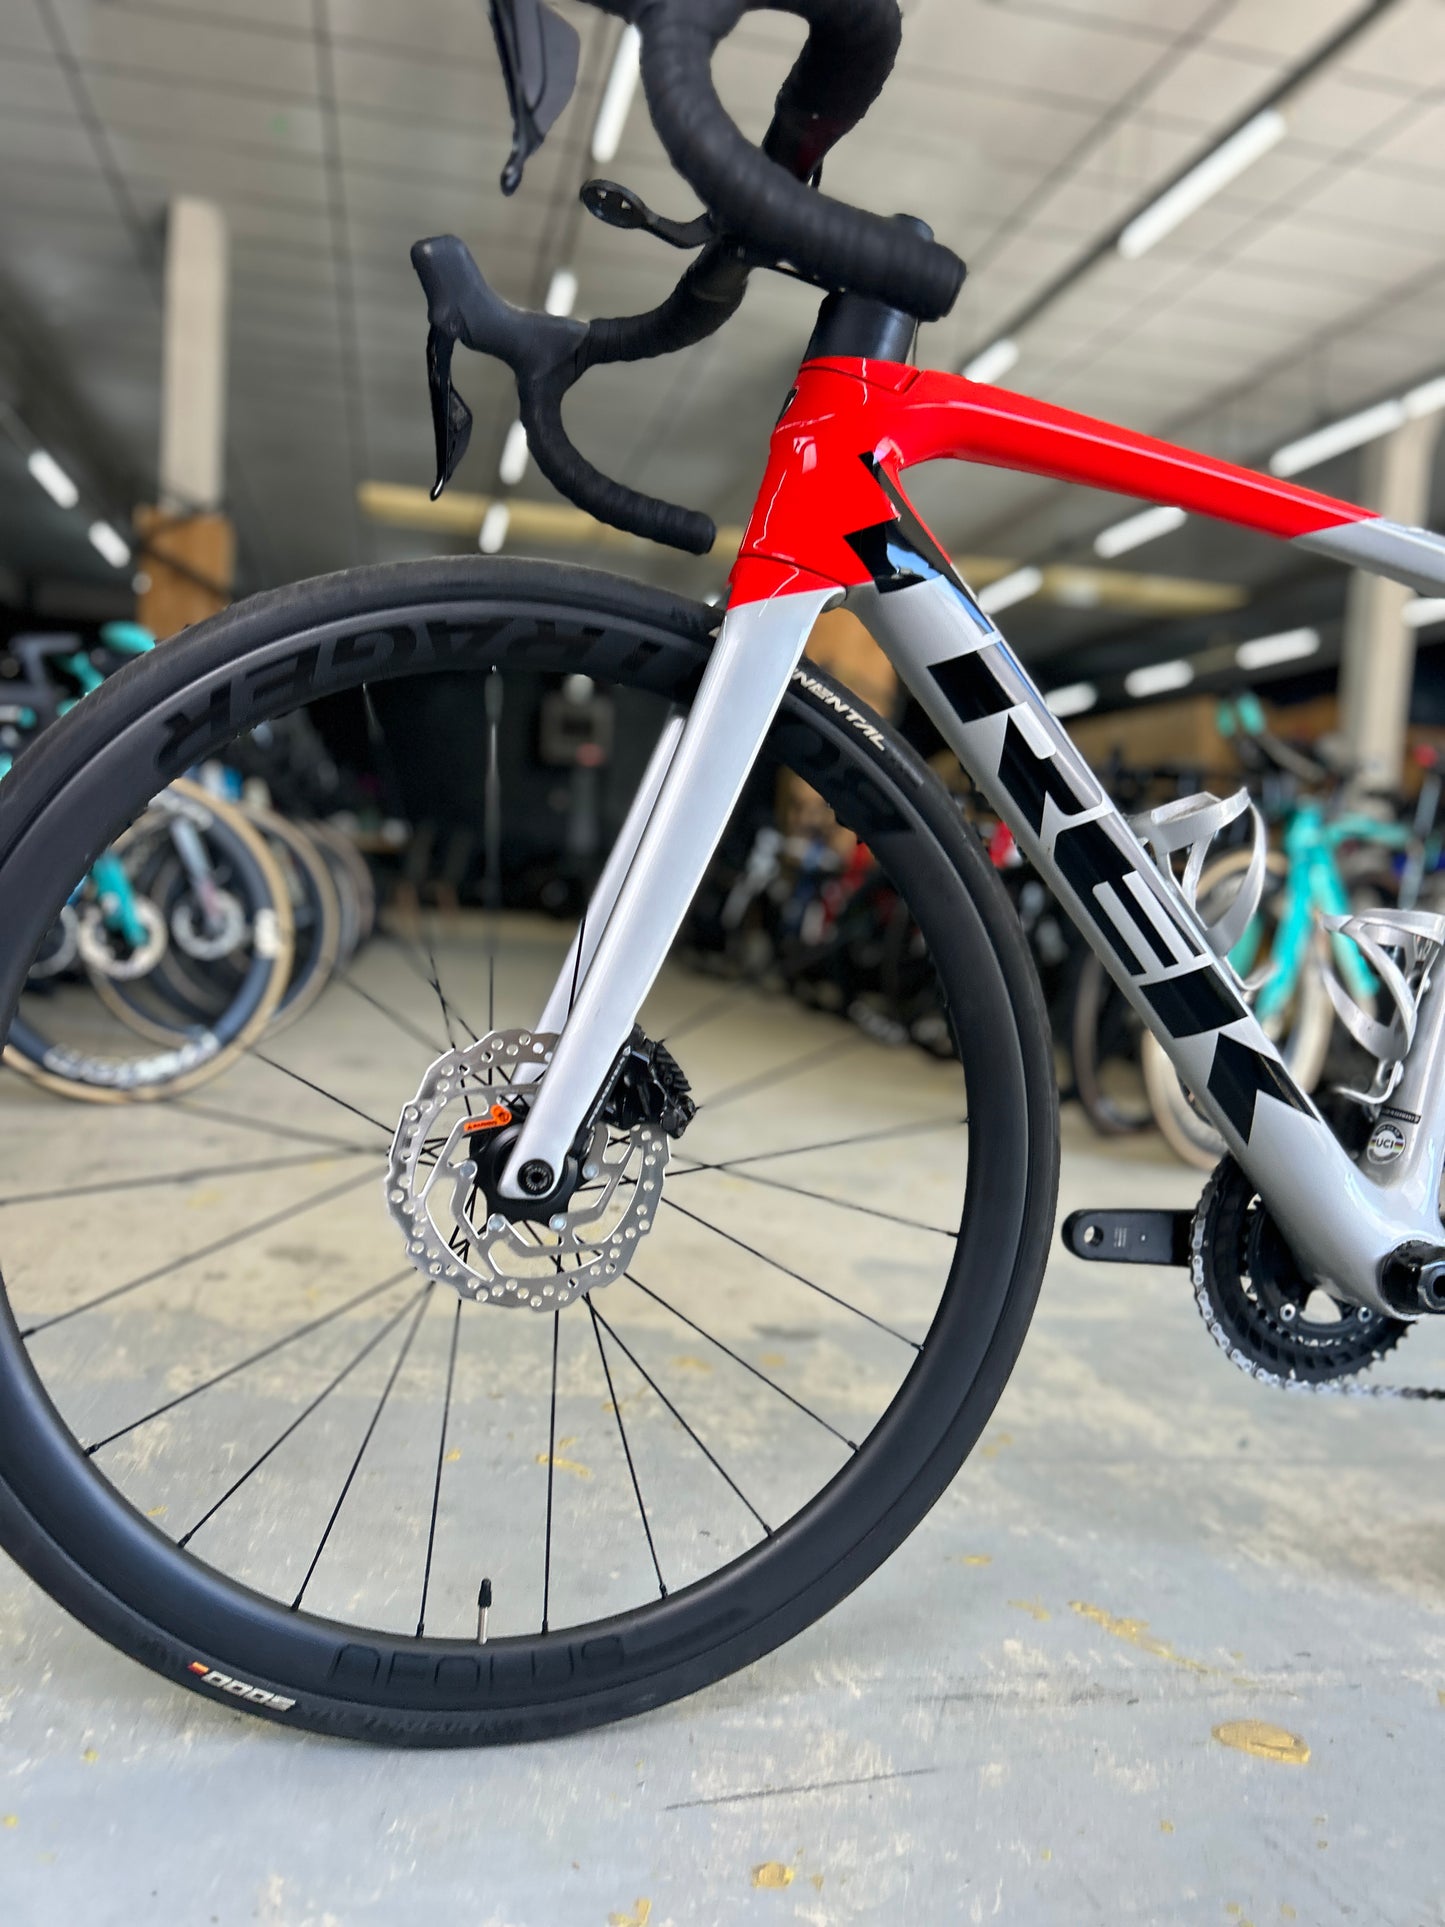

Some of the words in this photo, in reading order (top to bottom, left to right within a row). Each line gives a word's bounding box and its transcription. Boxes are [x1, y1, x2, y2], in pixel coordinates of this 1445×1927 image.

[791, 667, 886, 752] NENTAL
[843, 450, 1321, 1146] TREK
[1375, 1137, 1395, 1150] UCI
[201, 1670, 297, 1712] 5000
